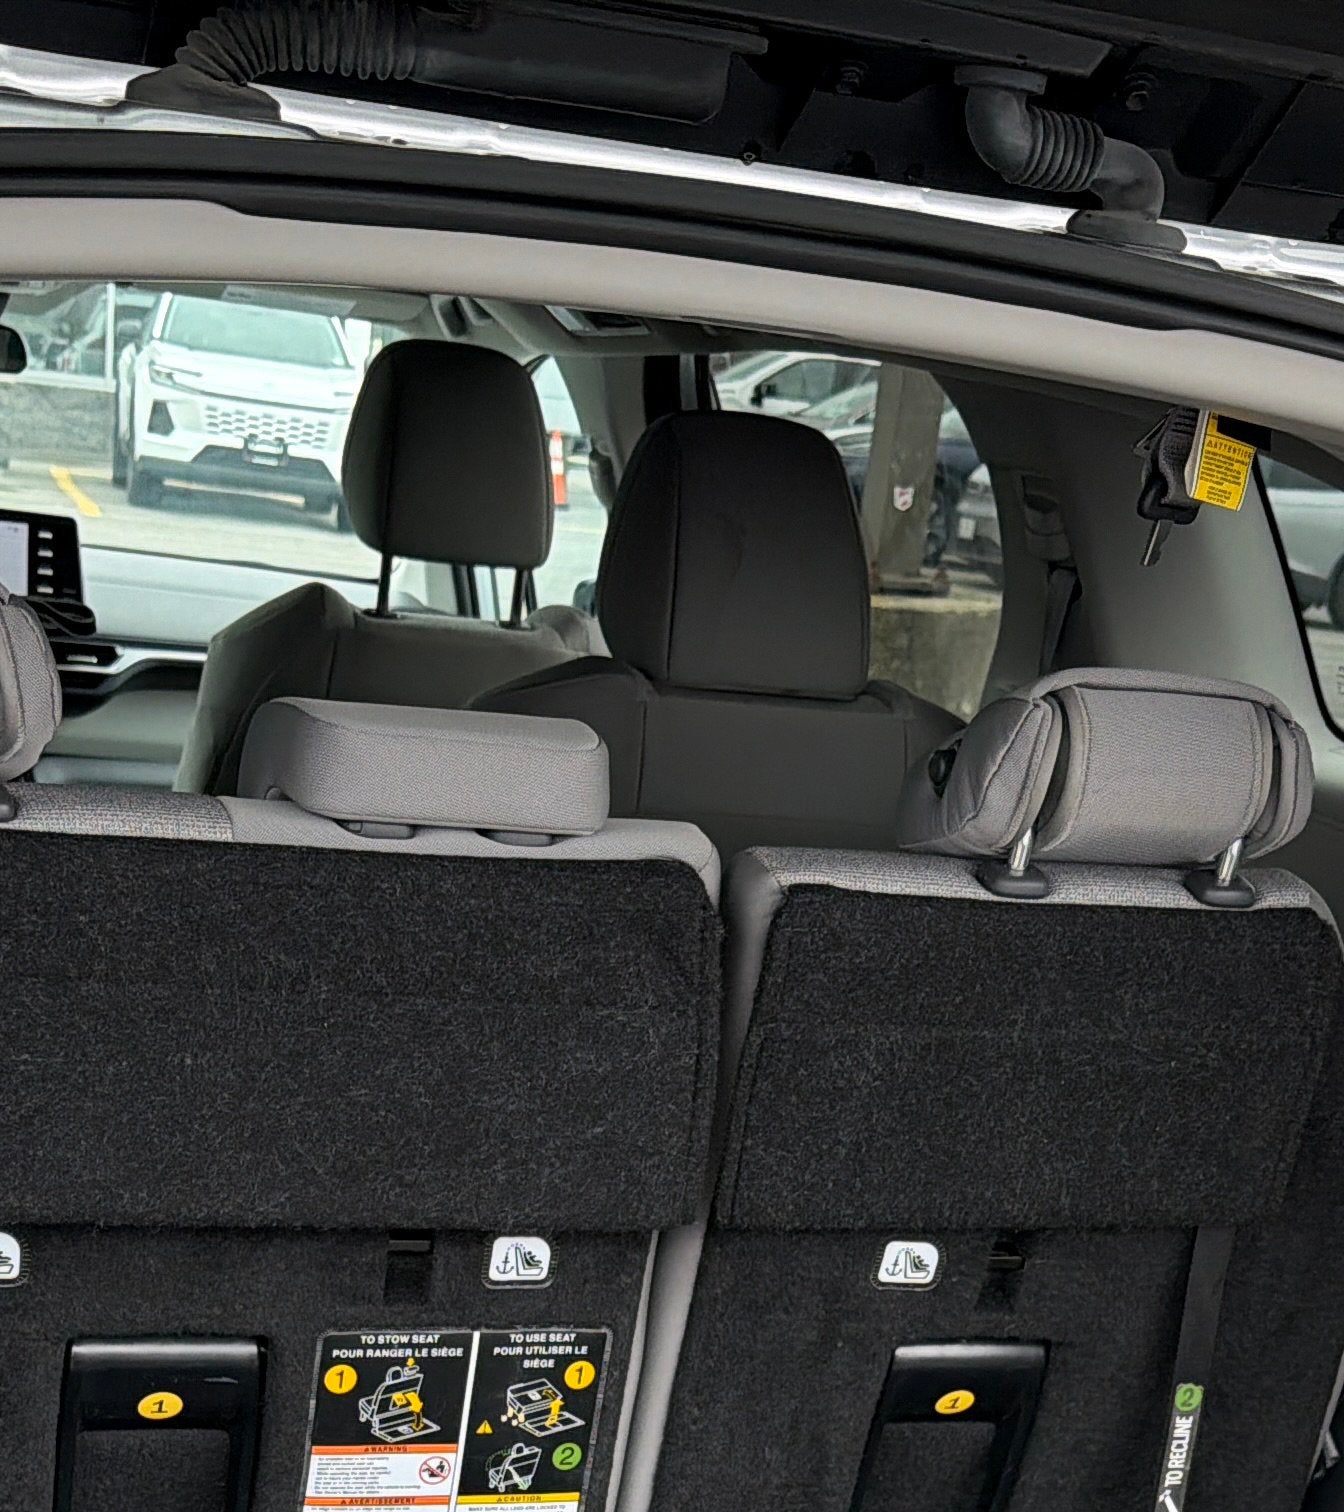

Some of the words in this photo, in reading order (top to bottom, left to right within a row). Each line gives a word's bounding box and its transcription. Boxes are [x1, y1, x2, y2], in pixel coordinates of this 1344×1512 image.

[360, 1335, 376, 1345] TO
[377, 1334, 411, 1345] STOW
[411, 1334, 441, 1344] SEAT
[509, 1333, 524, 1343] TO
[525, 1333, 548, 1343] USE
[548, 1332, 577, 1342] SEAT
[332, 1348, 364, 1359] POUR
[366, 1348, 412, 1358] RANGER
[415, 1348, 429, 1357] LE
[430, 1346, 464, 1357] SIÈGE
[493, 1346, 524, 1356] POUR
[525, 1345, 573, 1355] UTILISER
[574, 1345, 589, 1354] LE
[522, 1357, 556, 1369] SIÈGE
[336, 1369, 345, 1389] 1
[575, 1365, 584, 1385] 1
[943, 1396, 961, 1410] 1
[1180, 1387, 1194, 1408] 2
[150, 1399, 168, 1414] 1
[1167, 1415, 1194, 1469] RECLINE
[559, 1446, 575, 1466] 2
[1164, 1469, 1184, 1488] TO
